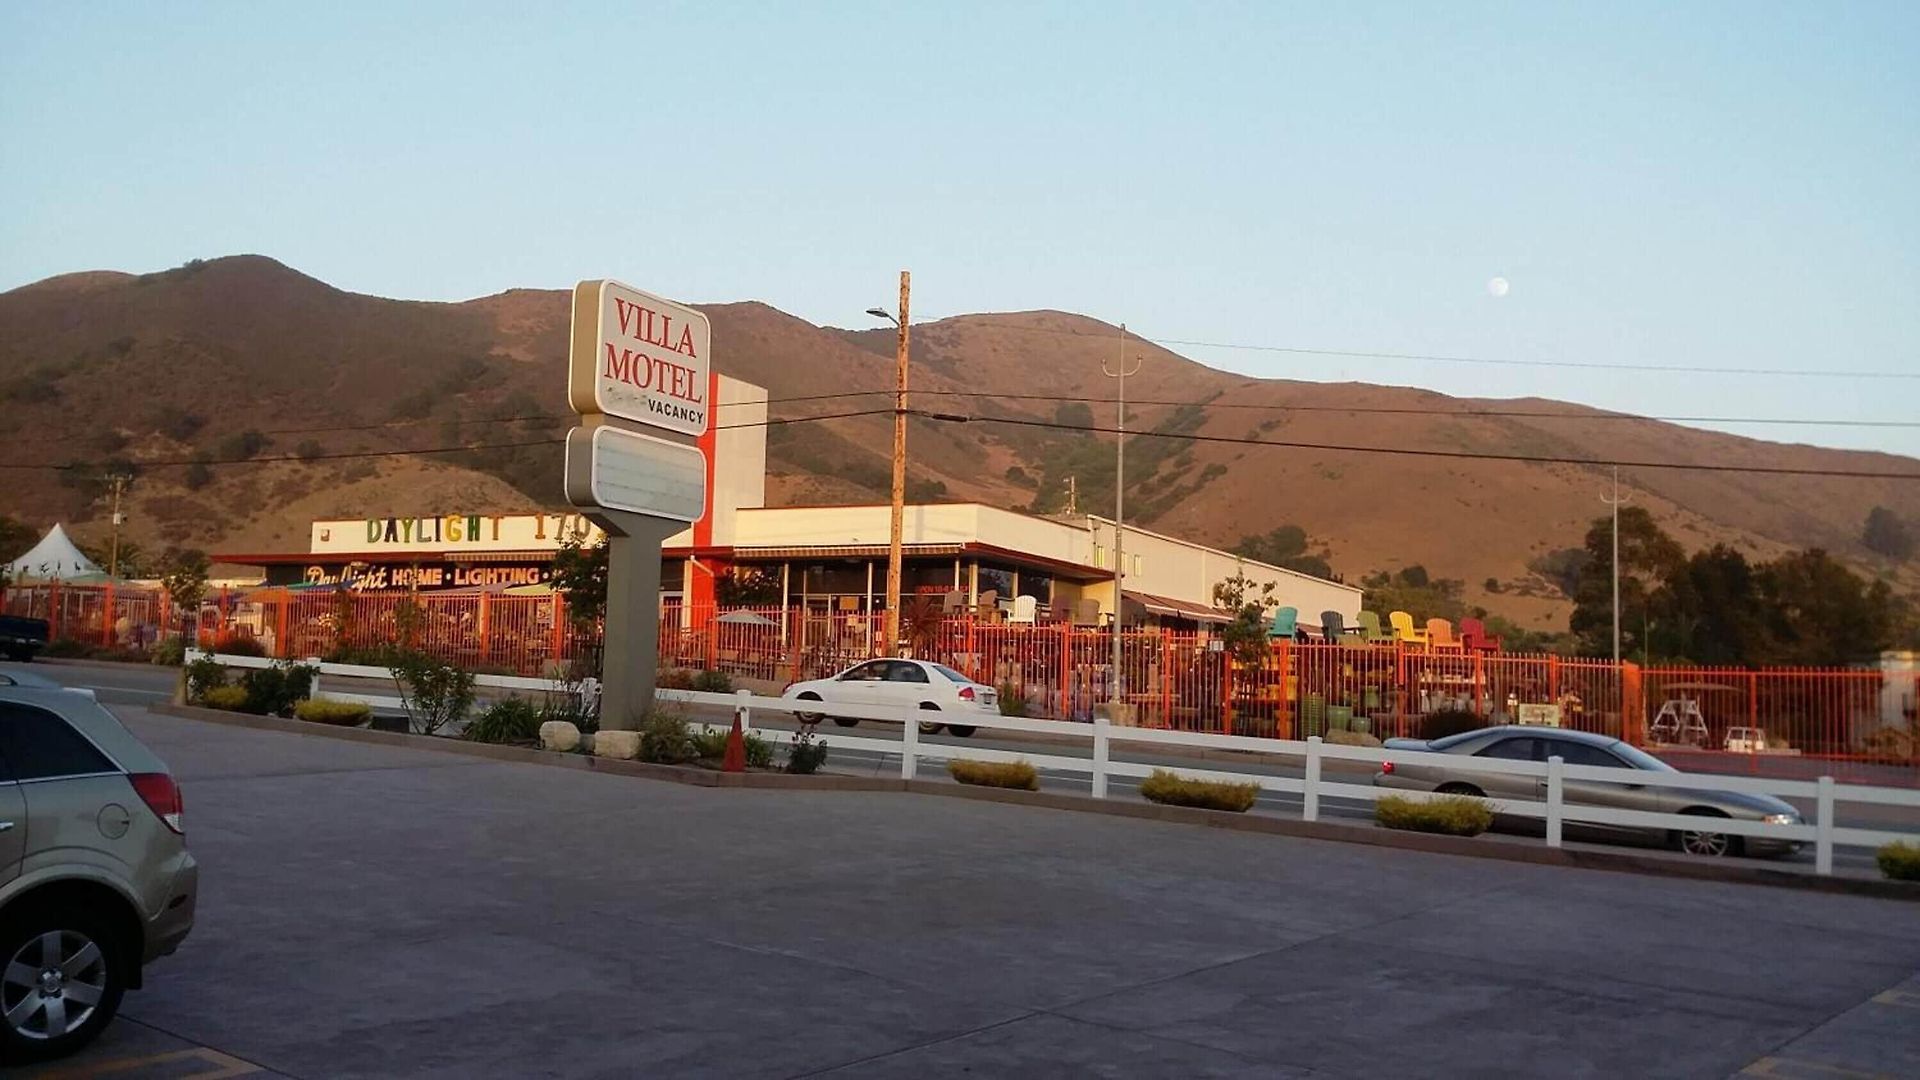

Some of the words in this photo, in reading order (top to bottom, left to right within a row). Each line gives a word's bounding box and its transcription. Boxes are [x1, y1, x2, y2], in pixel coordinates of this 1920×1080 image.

[614, 297, 697, 358] VILLA
[604, 342, 703, 404] MOTEL
[648, 398, 704, 424] VACANCY
[366, 513, 504, 543] DAYLIGHT
[534, 512, 606, 541] 170
[391, 568, 443, 586] HOME
[453, 567, 540, 586] LIGHTING
